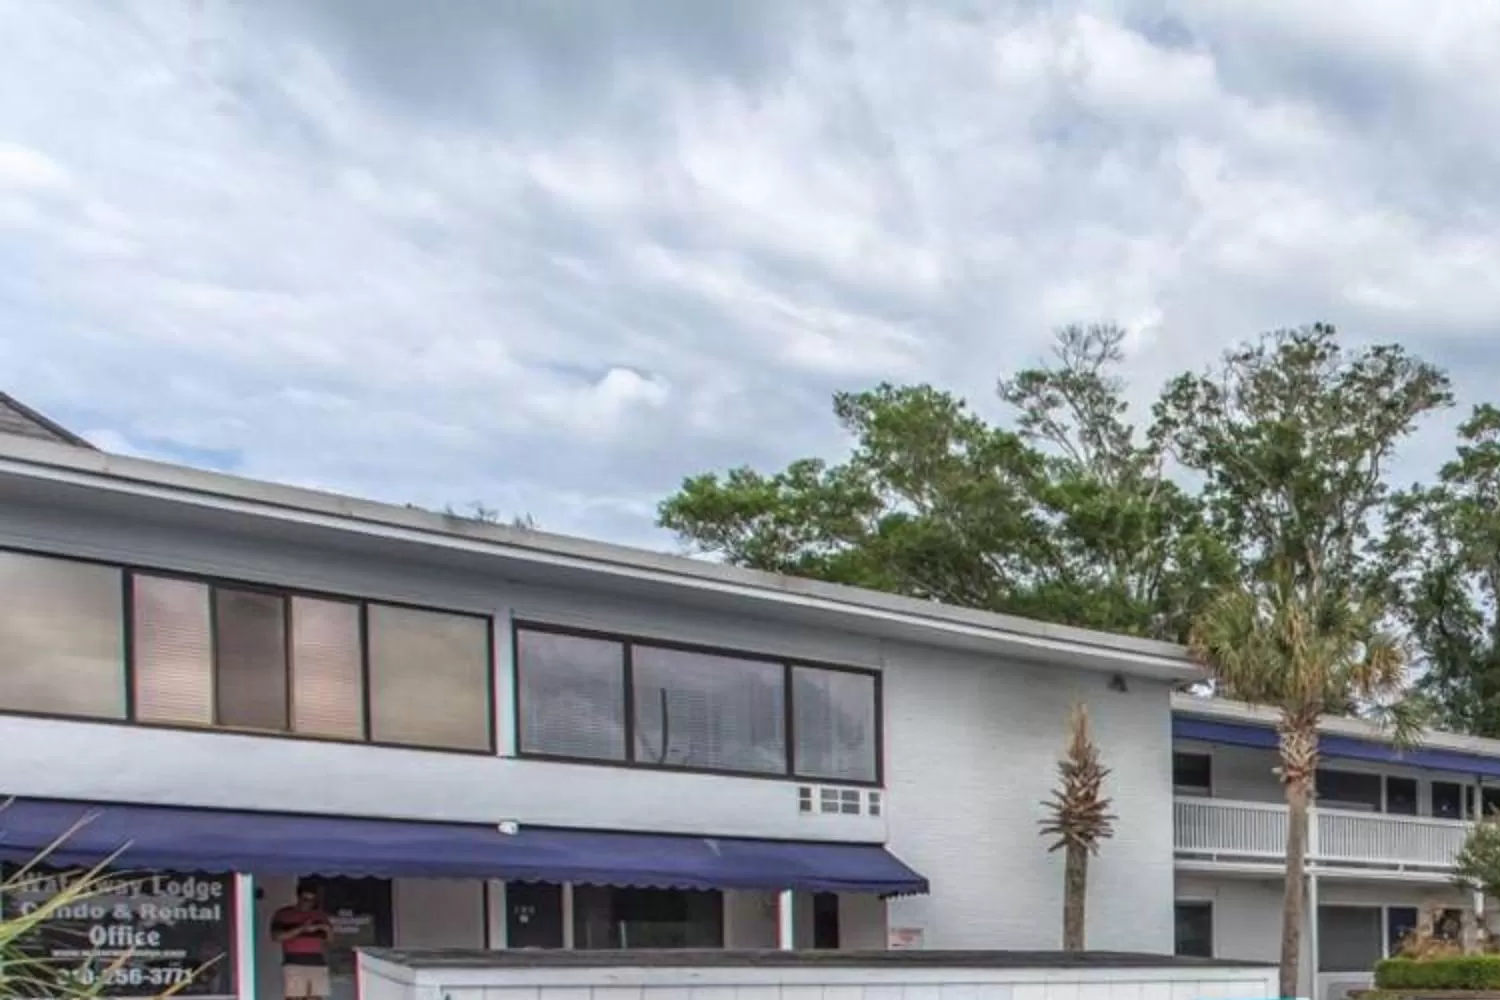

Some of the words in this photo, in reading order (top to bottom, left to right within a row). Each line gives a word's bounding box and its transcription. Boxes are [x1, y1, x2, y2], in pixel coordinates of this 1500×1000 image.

[20, 872, 143, 899] Watway
[153, 875, 223, 900] Lodge
[113, 903, 132, 919] &
[141, 903, 221, 920] Rental
[89, 925, 161, 946] Office
